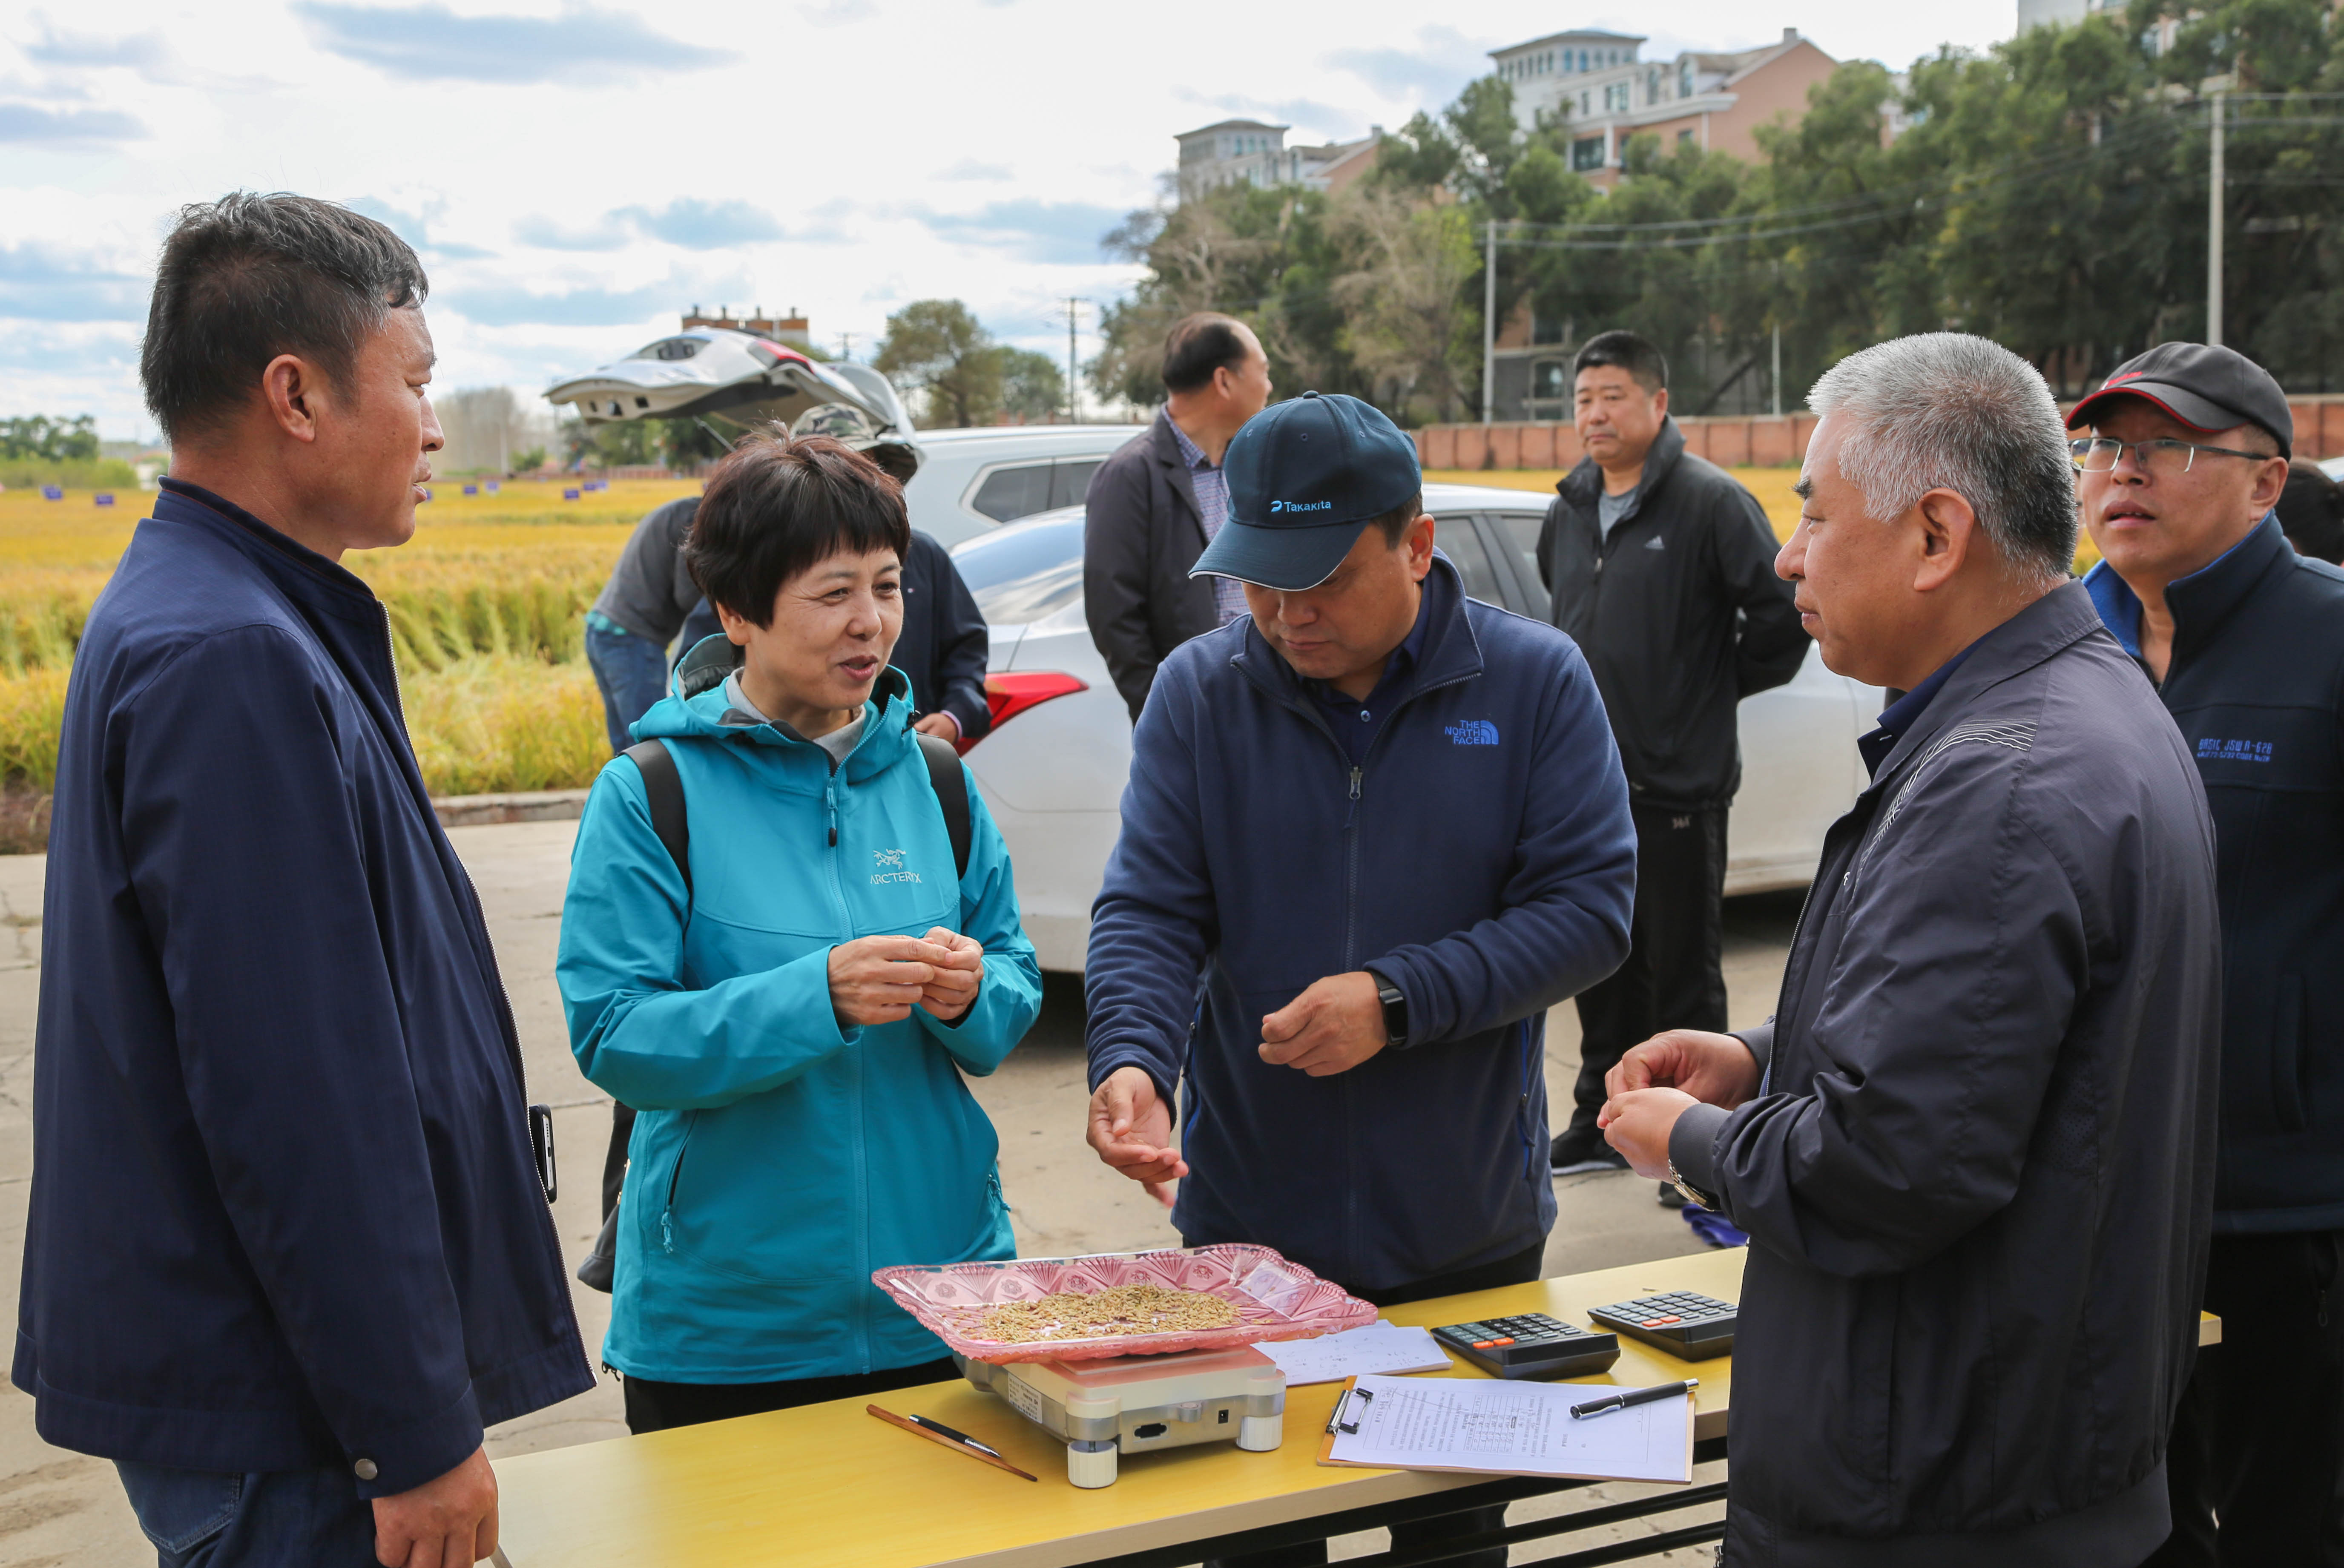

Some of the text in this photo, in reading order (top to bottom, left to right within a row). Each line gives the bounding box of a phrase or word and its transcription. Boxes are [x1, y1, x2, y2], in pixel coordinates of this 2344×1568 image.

[1284, 500, 1331, 512] Takakita
[1460, 720, 1480, 728] THE
[1445, 727, 1480, 736] NORTH
[1453, 736, 1481, 745] FACE
